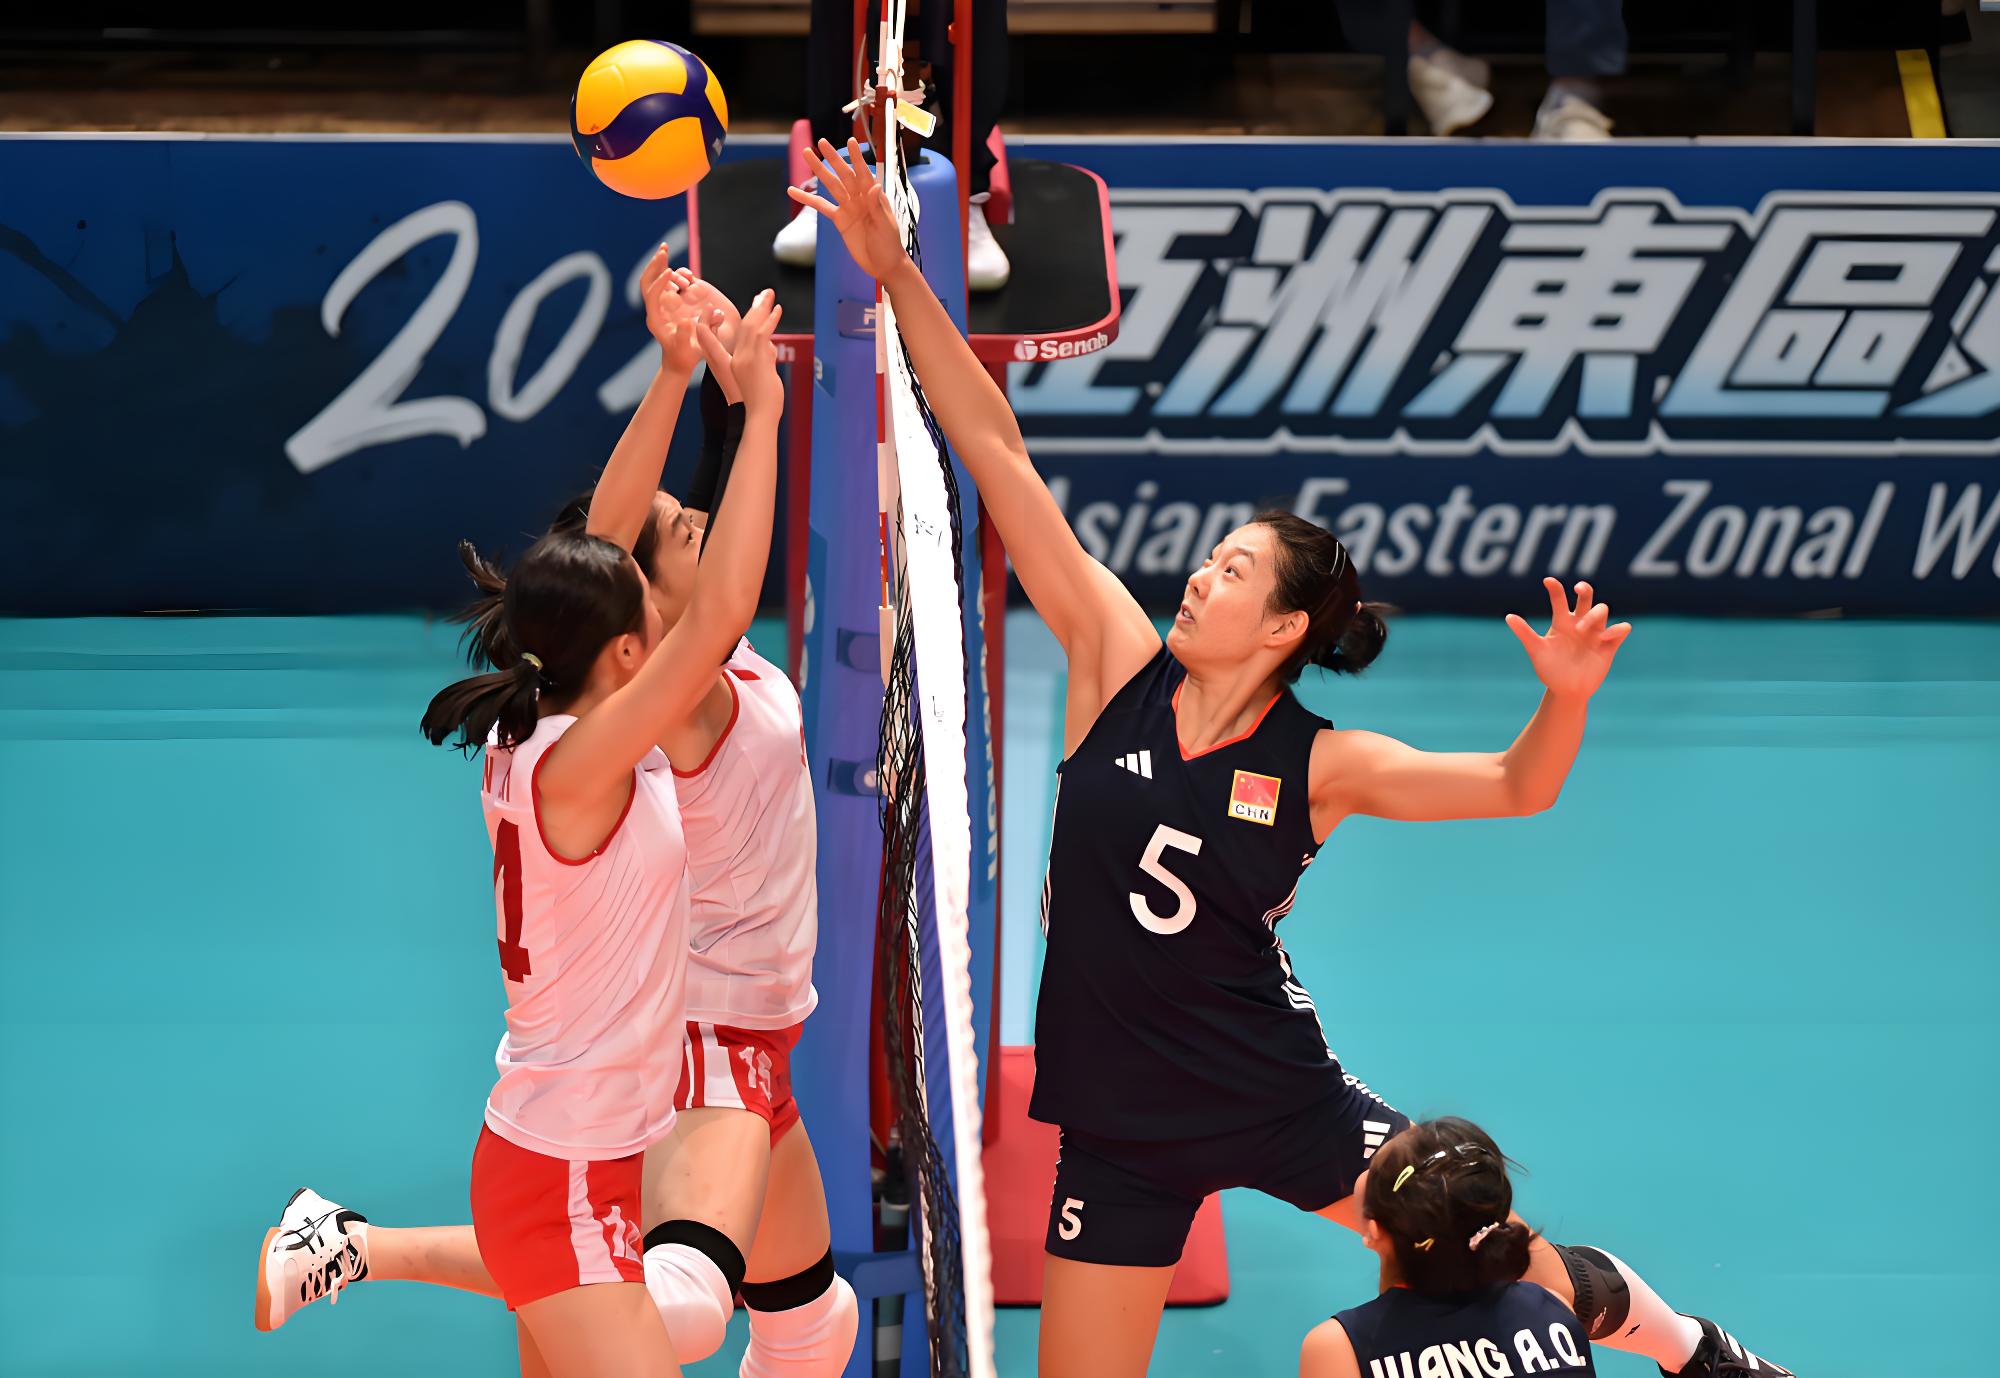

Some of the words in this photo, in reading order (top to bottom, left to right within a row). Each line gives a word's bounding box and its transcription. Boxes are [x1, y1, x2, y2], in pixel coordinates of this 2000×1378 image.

[1046, 476, 1254, 575] sian
[1629, 480, 1895, 578] Zonal
[1912, 482, 2000, 579] W
[1235, 803, 1269, 820] CHN
[1130, 823, 1202, 935] 5
[1058, 1197, 1084, 1240] 5
[1369, 1337, 1514, 1378] WANG
